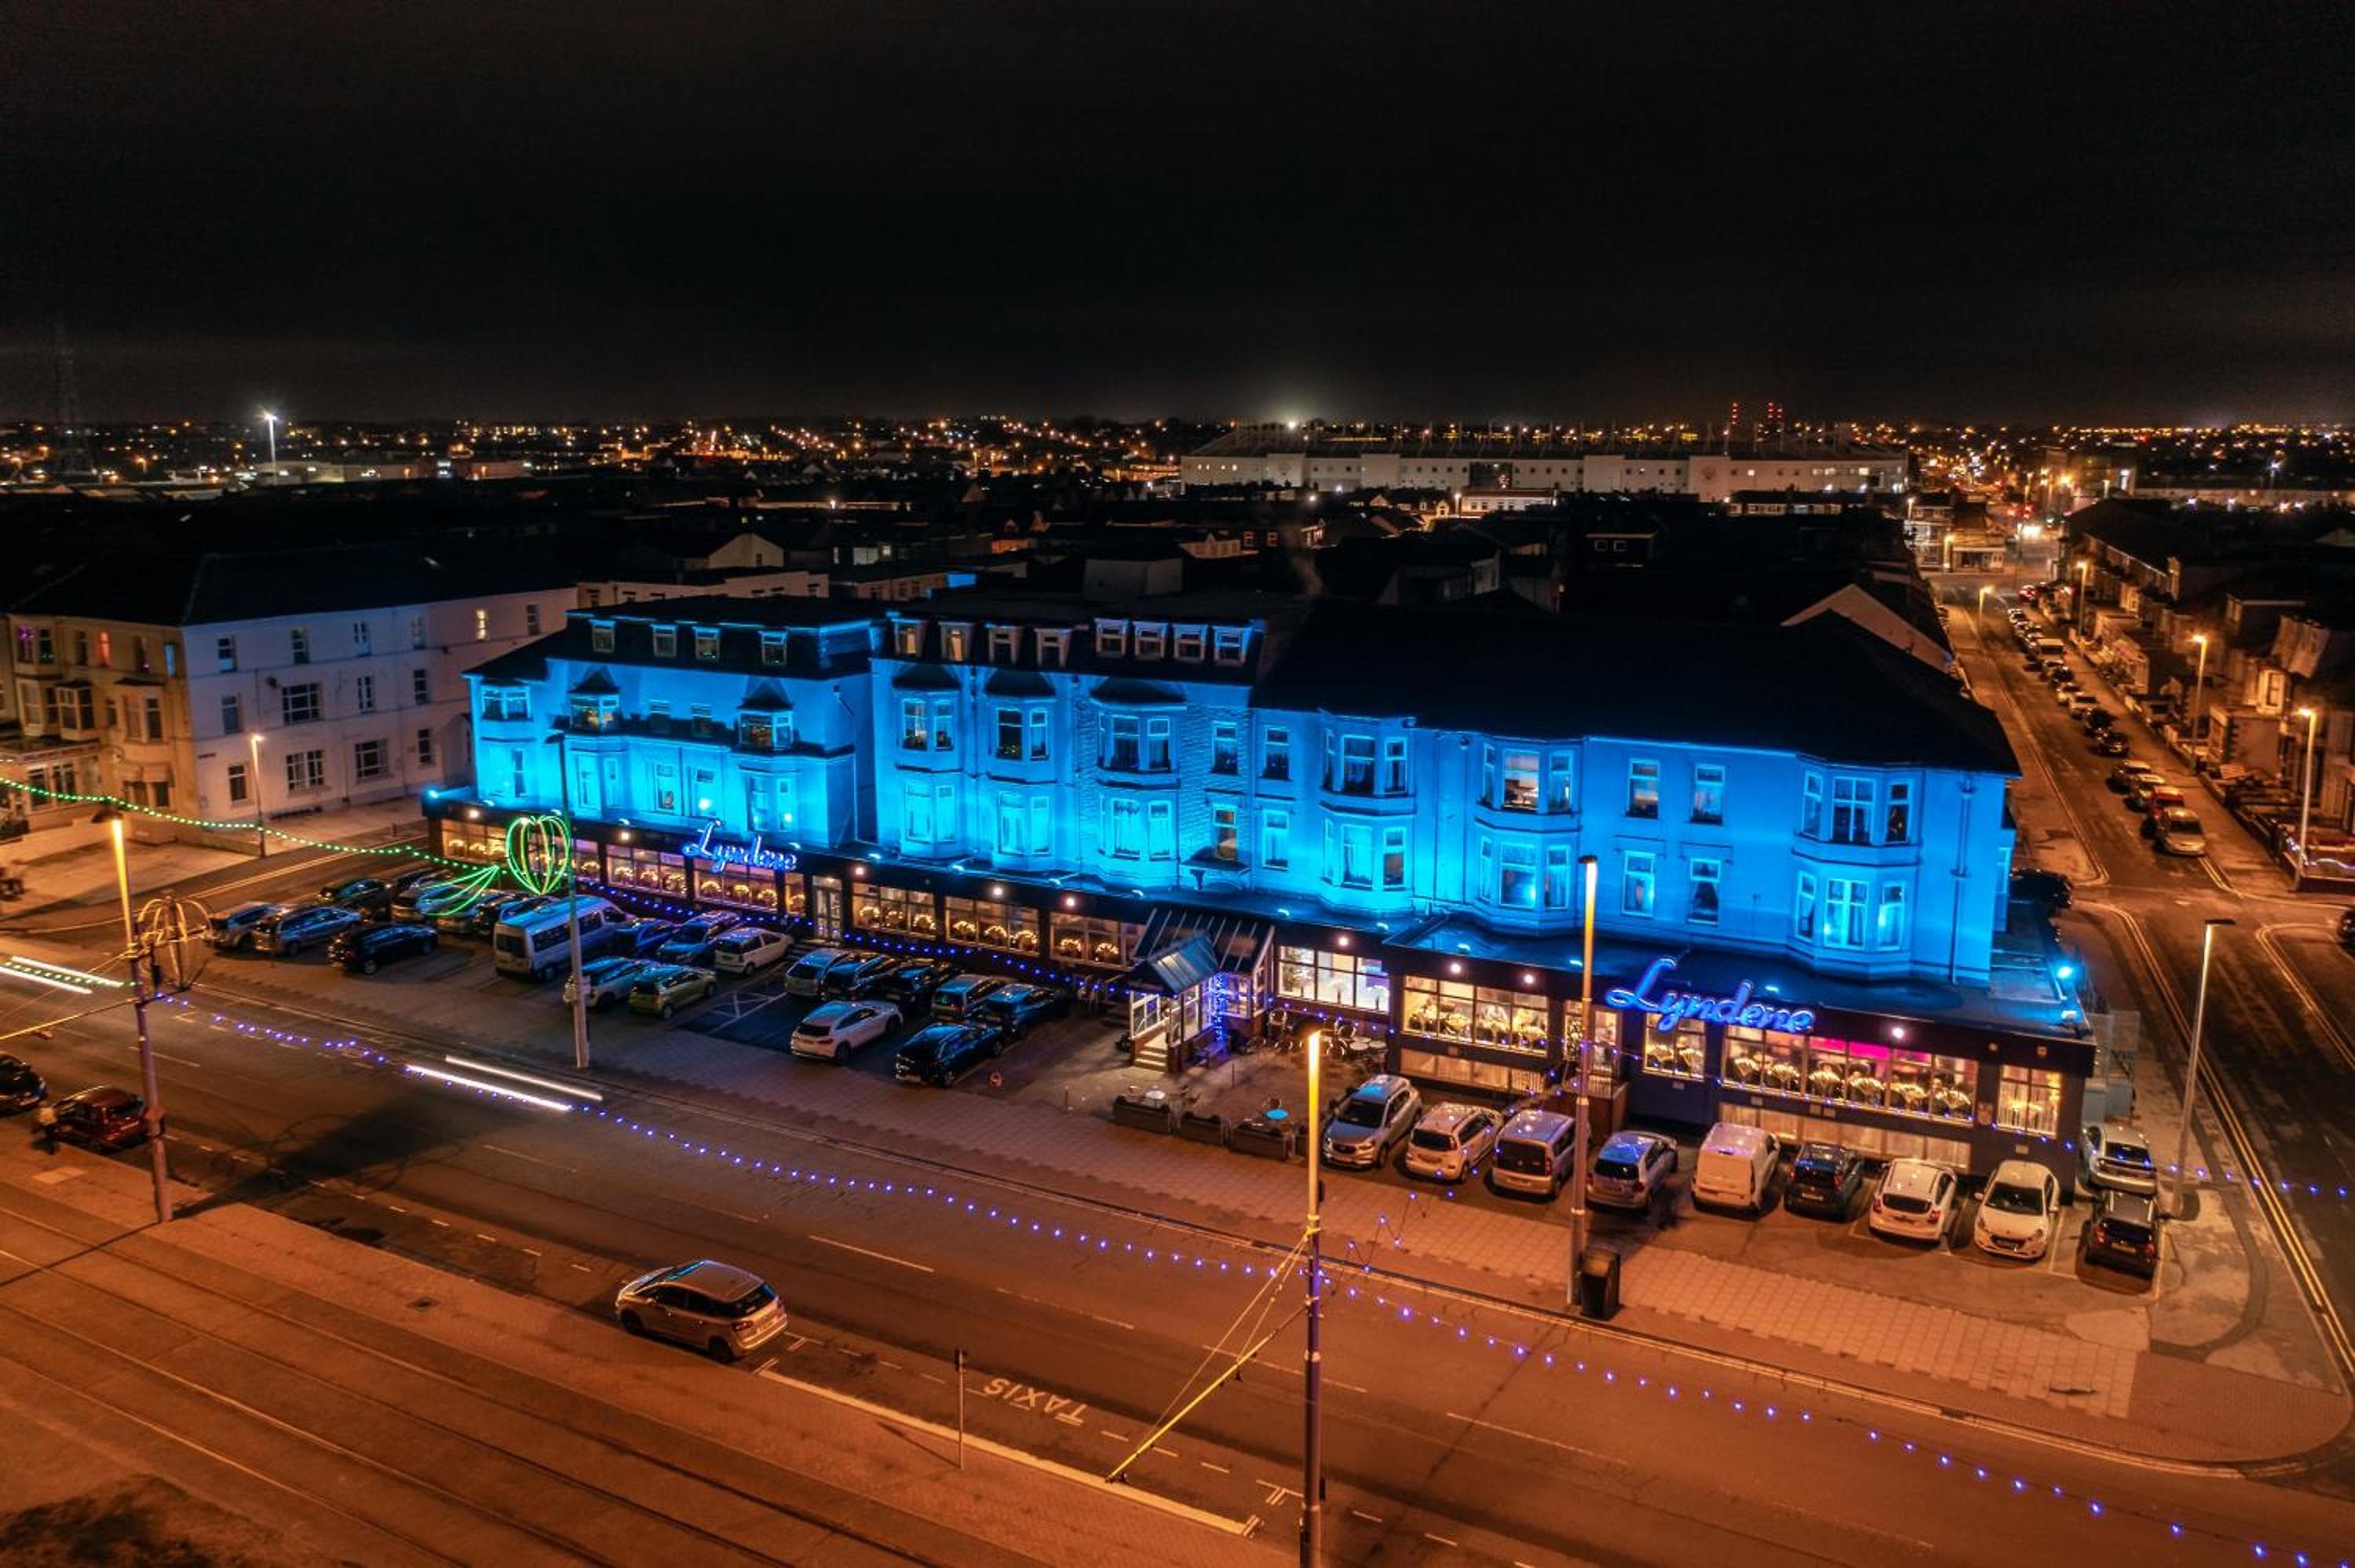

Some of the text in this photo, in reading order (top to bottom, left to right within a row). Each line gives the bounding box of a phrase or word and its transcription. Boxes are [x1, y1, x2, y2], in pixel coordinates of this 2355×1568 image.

[681, 819, 798, 873] Lyndene
[1605, 956, 1816, 1033] Lyndene
[983, 1377, 1089, 1424] TAXIS
